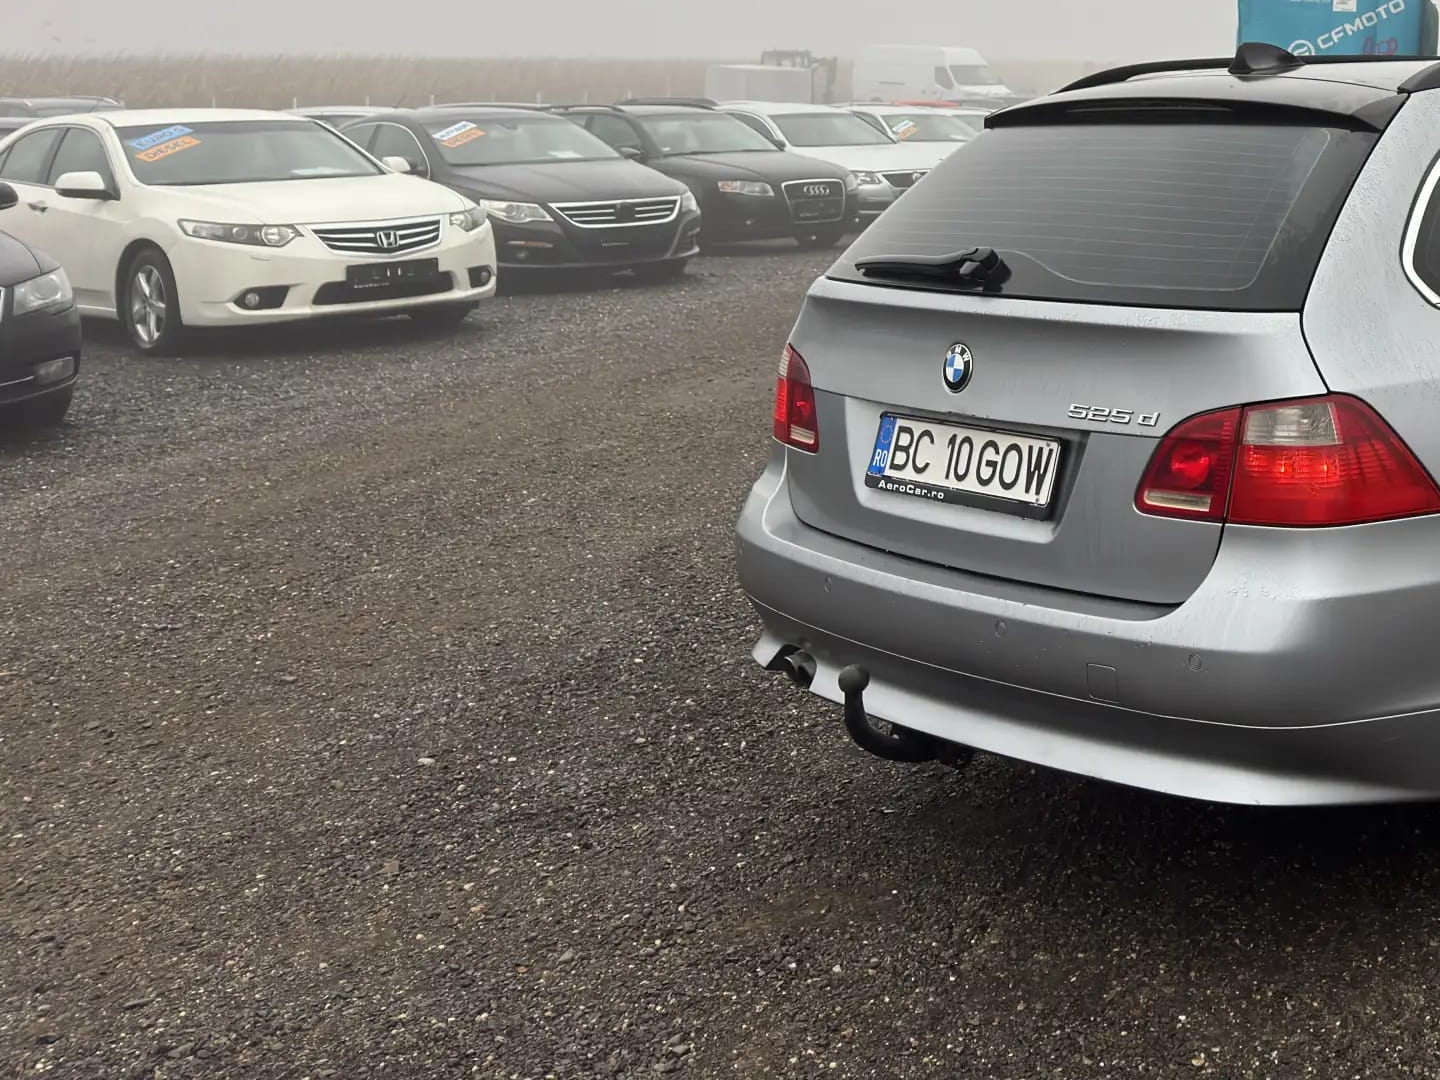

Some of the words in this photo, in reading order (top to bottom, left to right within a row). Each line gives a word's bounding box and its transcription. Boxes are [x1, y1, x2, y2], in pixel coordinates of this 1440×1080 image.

[947, 345, 970, 363] BMW
[1067, 403, 1135, 425] 525
[872, 448, 888, 468] RO
[889, 425, 935, 474] BC
[877, 478, 945, 500] AeroCar.ro
